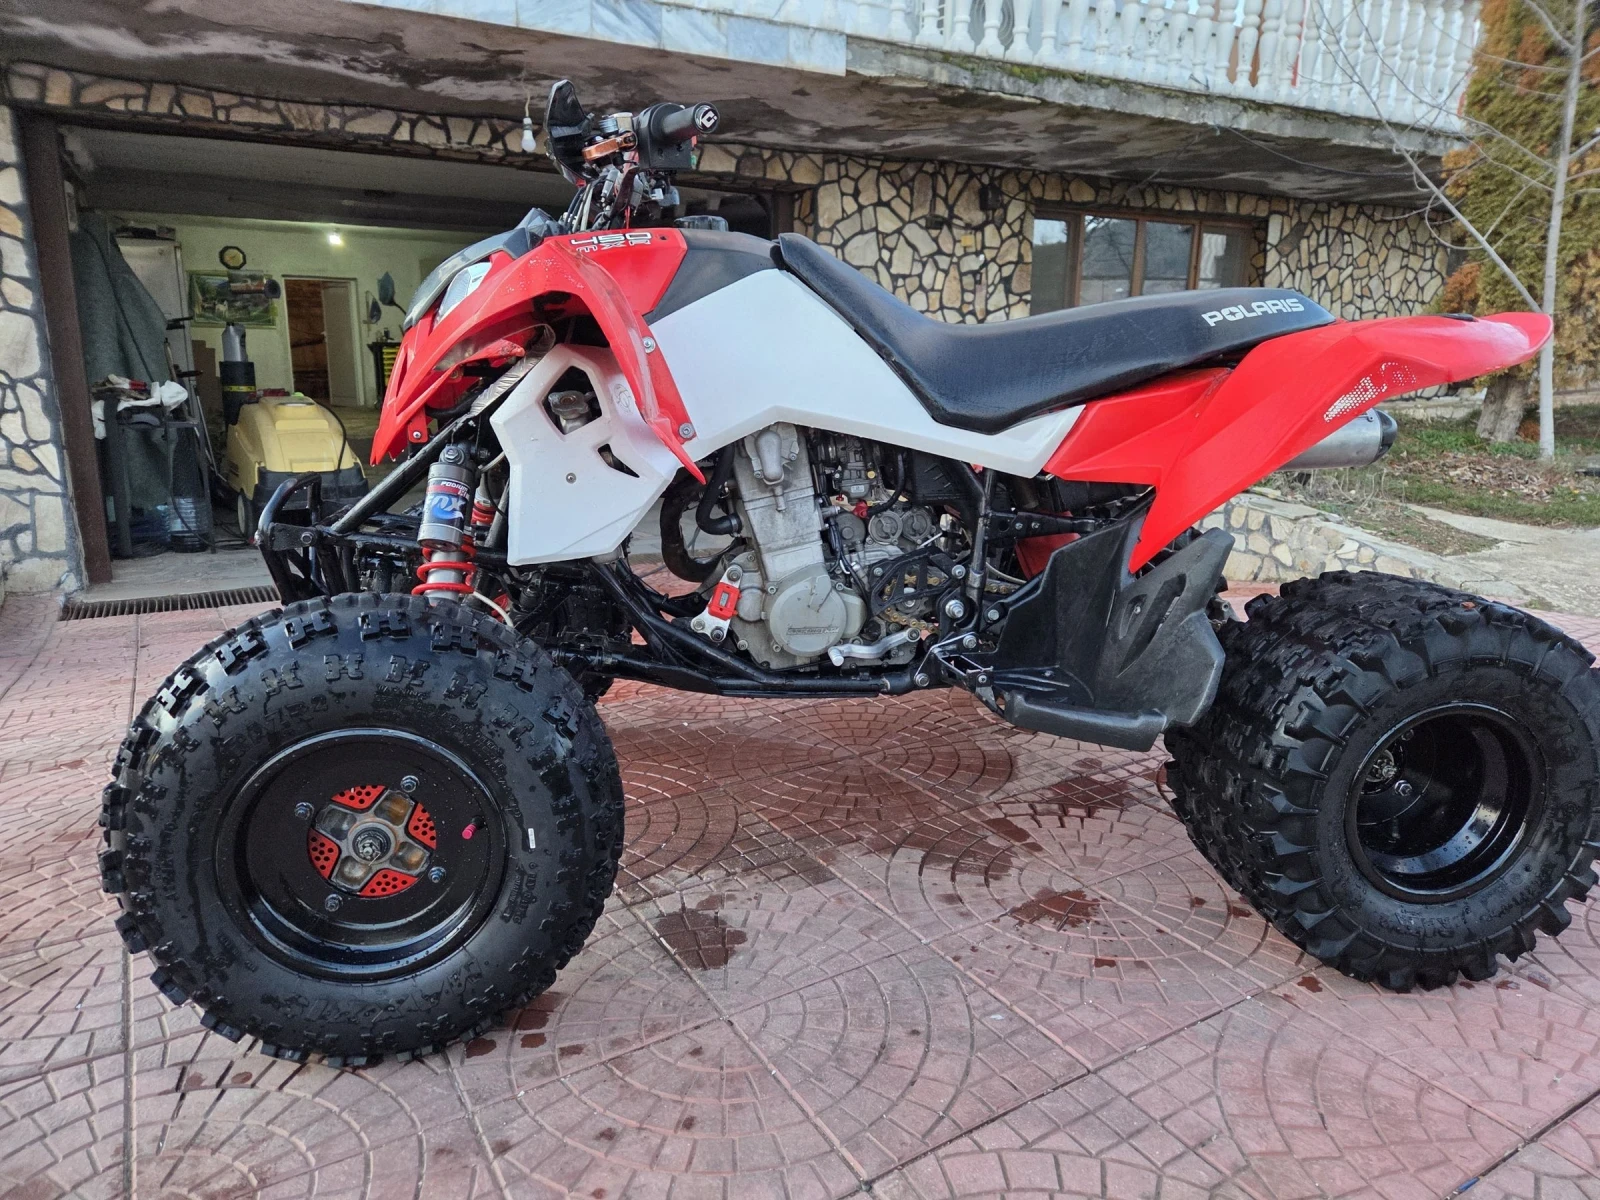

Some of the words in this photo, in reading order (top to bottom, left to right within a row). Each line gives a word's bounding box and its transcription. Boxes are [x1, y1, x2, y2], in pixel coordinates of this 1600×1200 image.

[571, 232, 652, 245] 450
[1201, 298, 1305, 327] POLARIS
[440, 481, 468, 492] PODIUM
